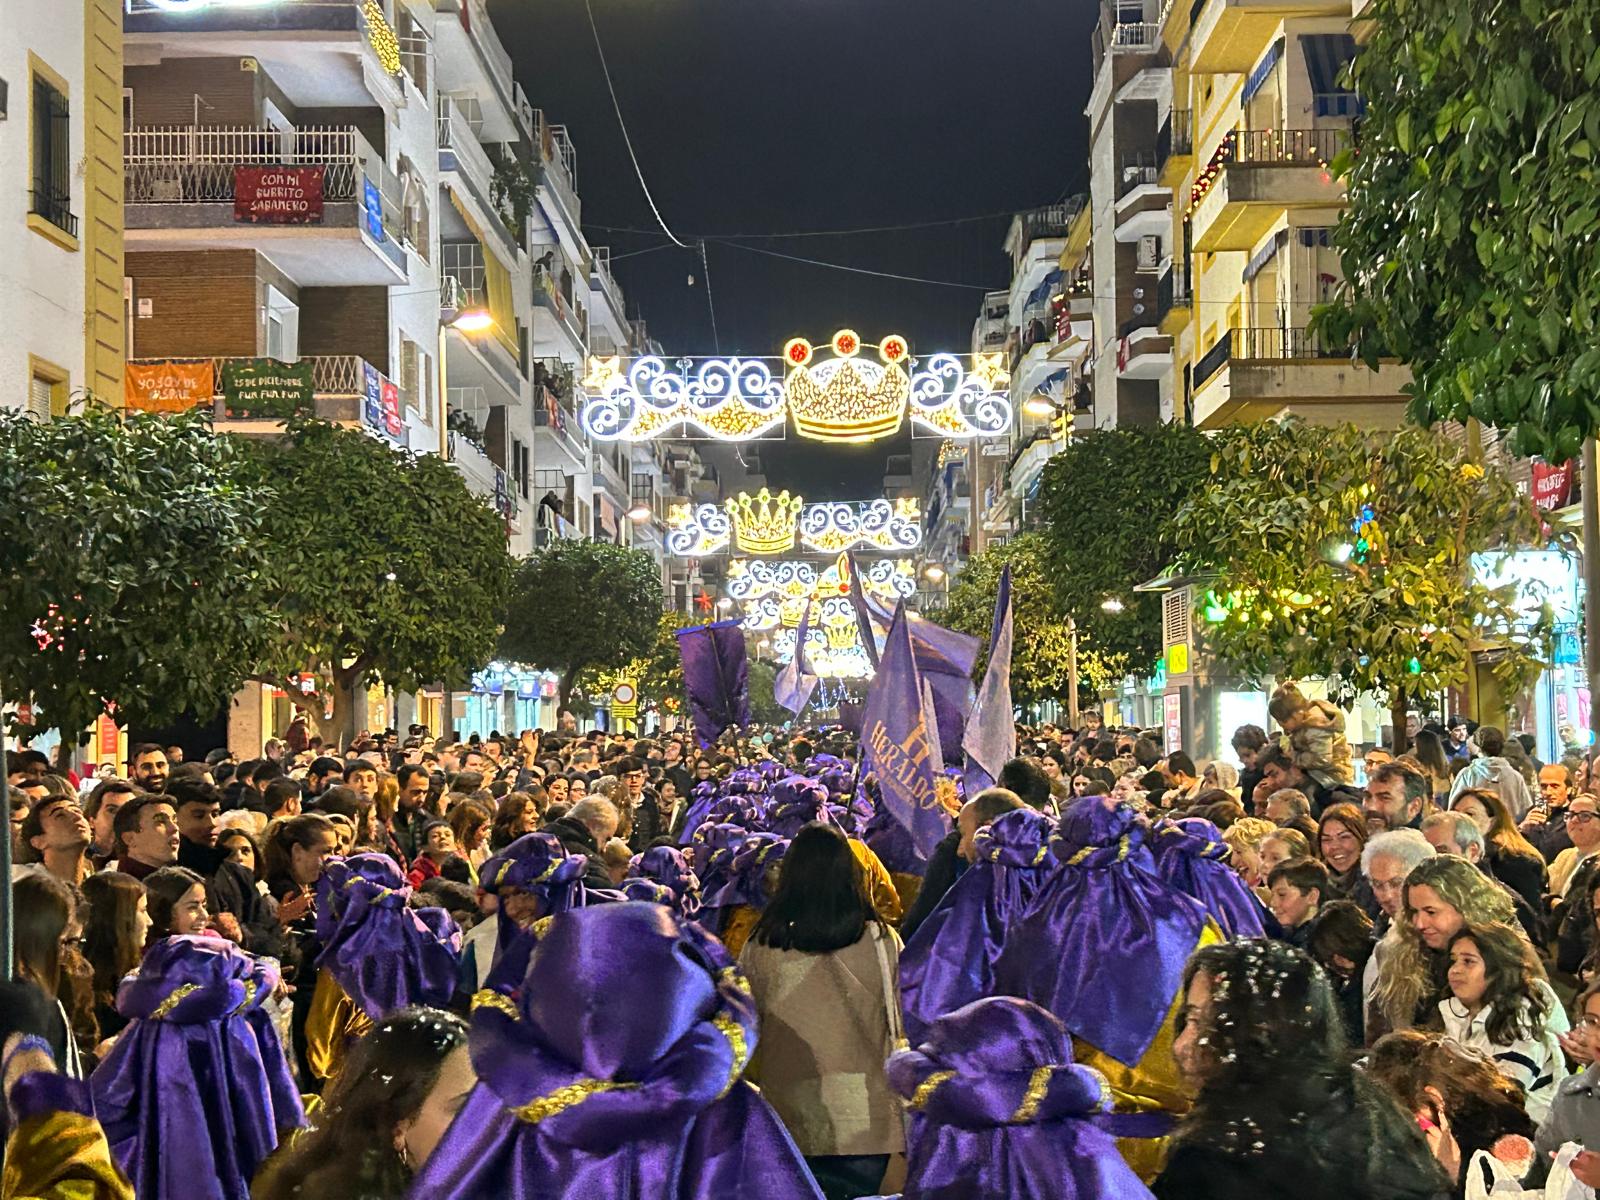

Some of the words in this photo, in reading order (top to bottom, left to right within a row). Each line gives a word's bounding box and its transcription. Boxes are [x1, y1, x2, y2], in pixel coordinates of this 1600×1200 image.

[261, 174, 284, 186] CON
[286, 174, 300, 186] MI
[256, 187, 304, 199] BURRITO
[250, 200, 308, 212] SABANERO
[137, 378, 155, 390] YO
[260, 389, 279, 400] FUN
[870, 720, 938, 810] HERALDO
